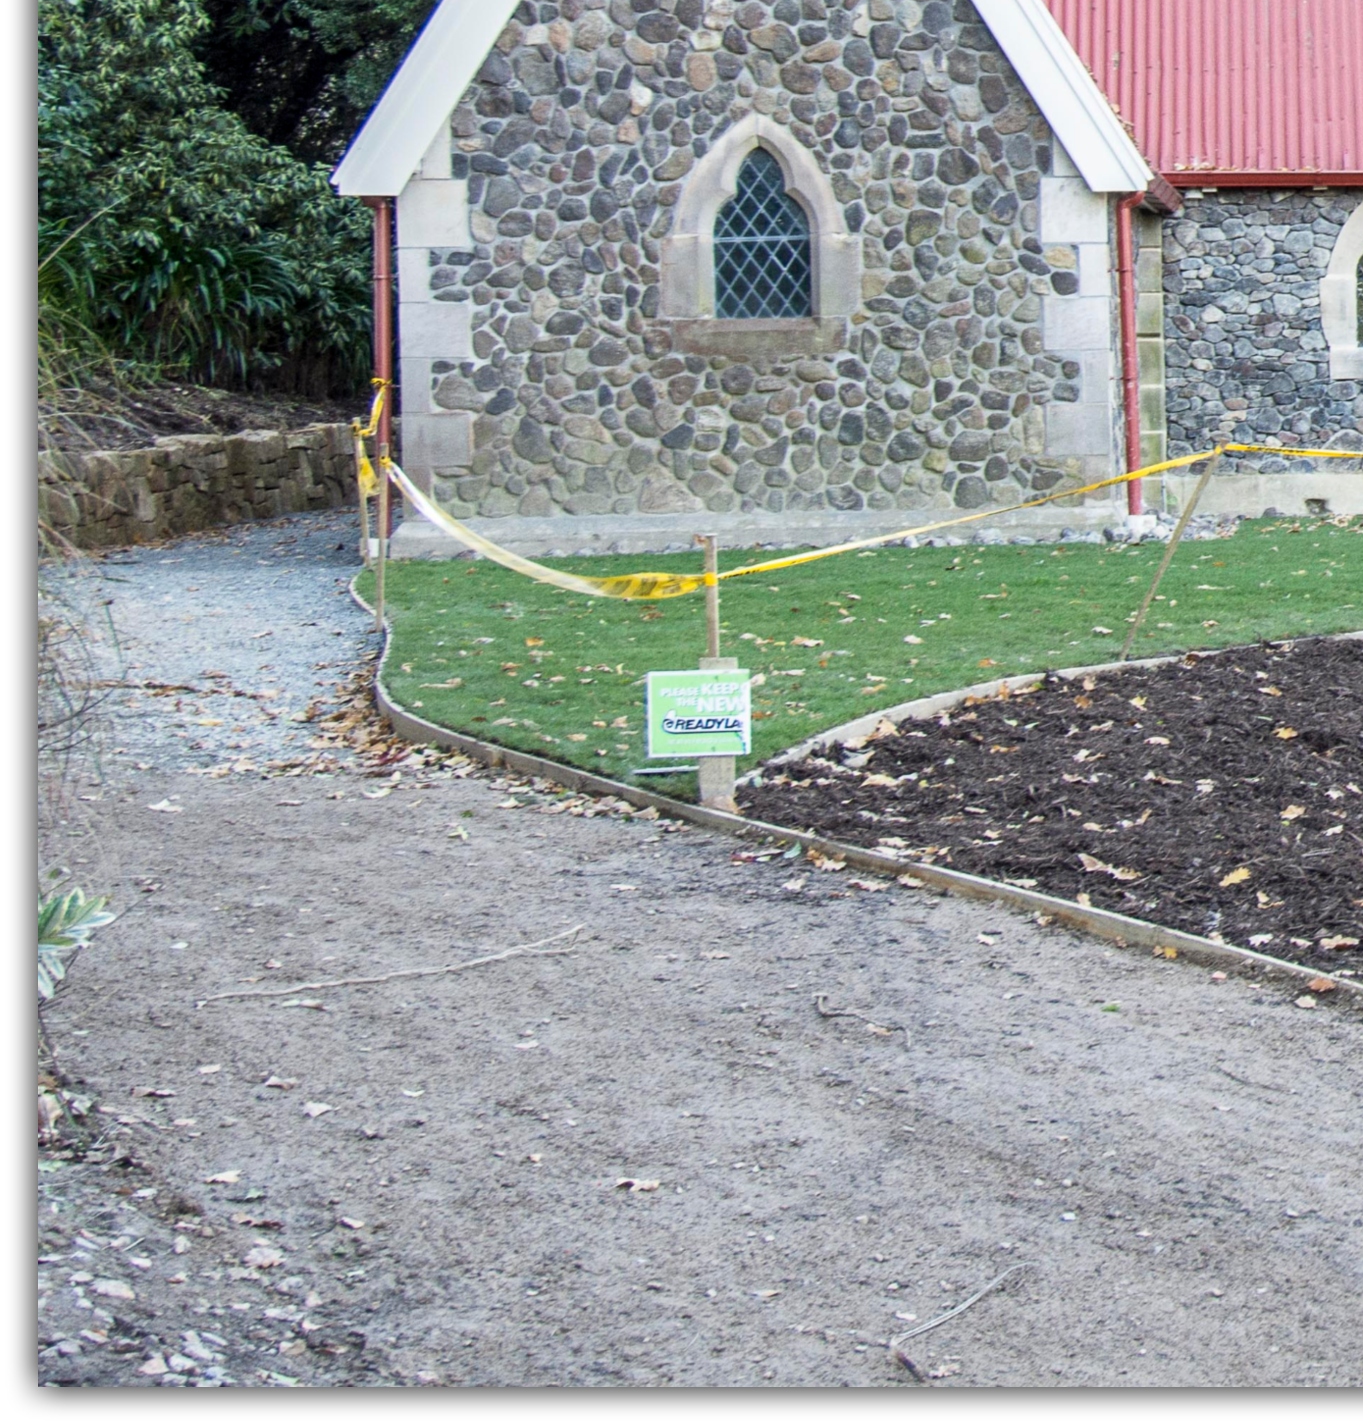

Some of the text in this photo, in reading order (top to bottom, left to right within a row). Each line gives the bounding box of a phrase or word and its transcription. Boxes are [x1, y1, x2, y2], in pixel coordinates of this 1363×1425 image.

[660, 687, 699, 697] PLEASE
[700, 682, 739, 696] KEEP
[676, 696, 745, 713] THE NEW
[675, 718, 743, 730] READYLA
